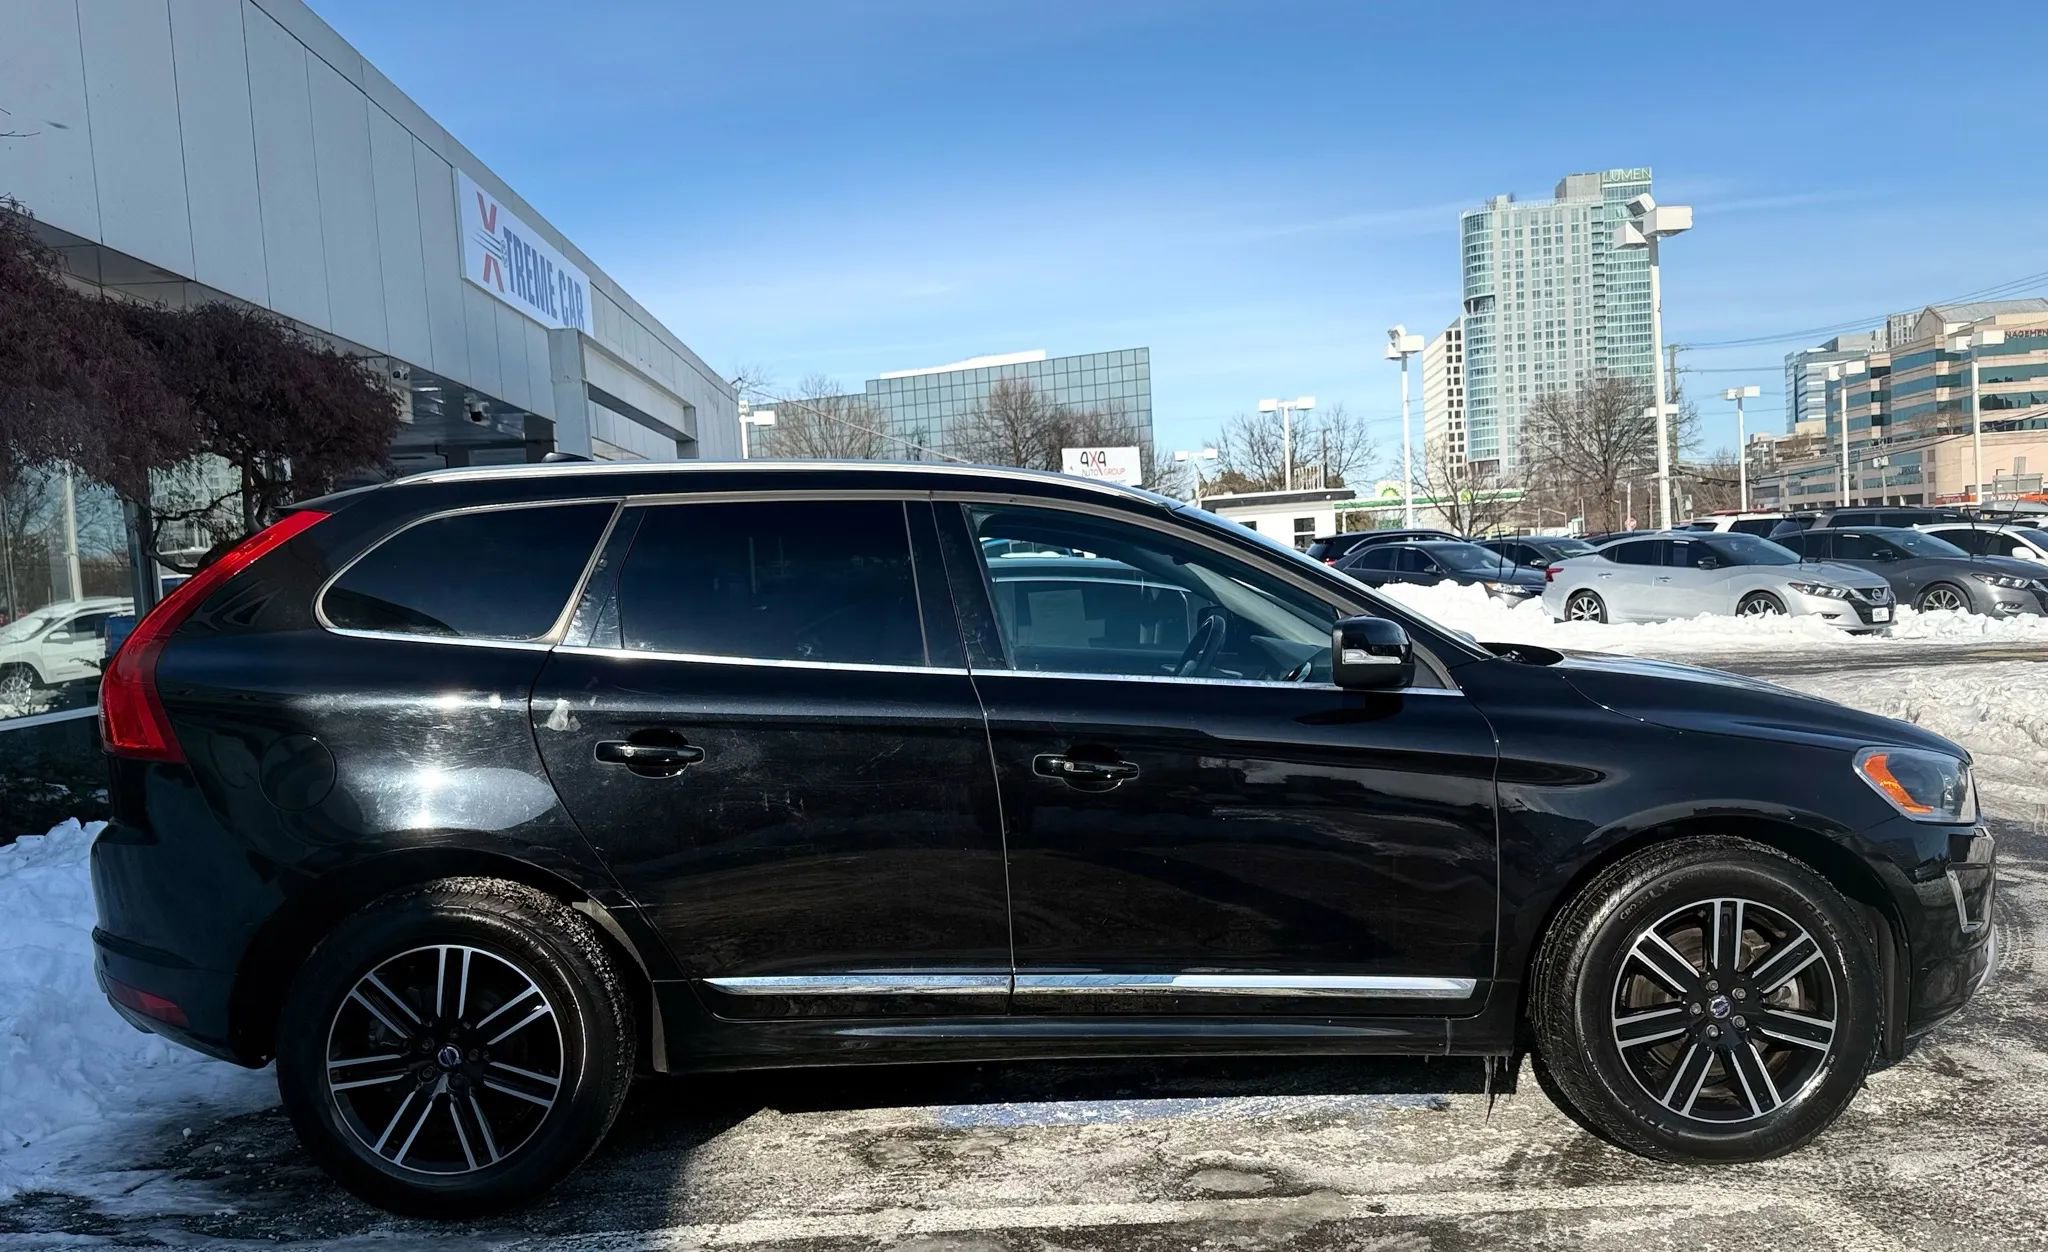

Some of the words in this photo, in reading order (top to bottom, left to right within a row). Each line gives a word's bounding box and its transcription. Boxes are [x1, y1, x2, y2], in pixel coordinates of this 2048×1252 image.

[1604, 167, 1652, 182] LUMEN
[558, 269, 585, 333] CAR
[1080, 451, 1106, 475] AXA
